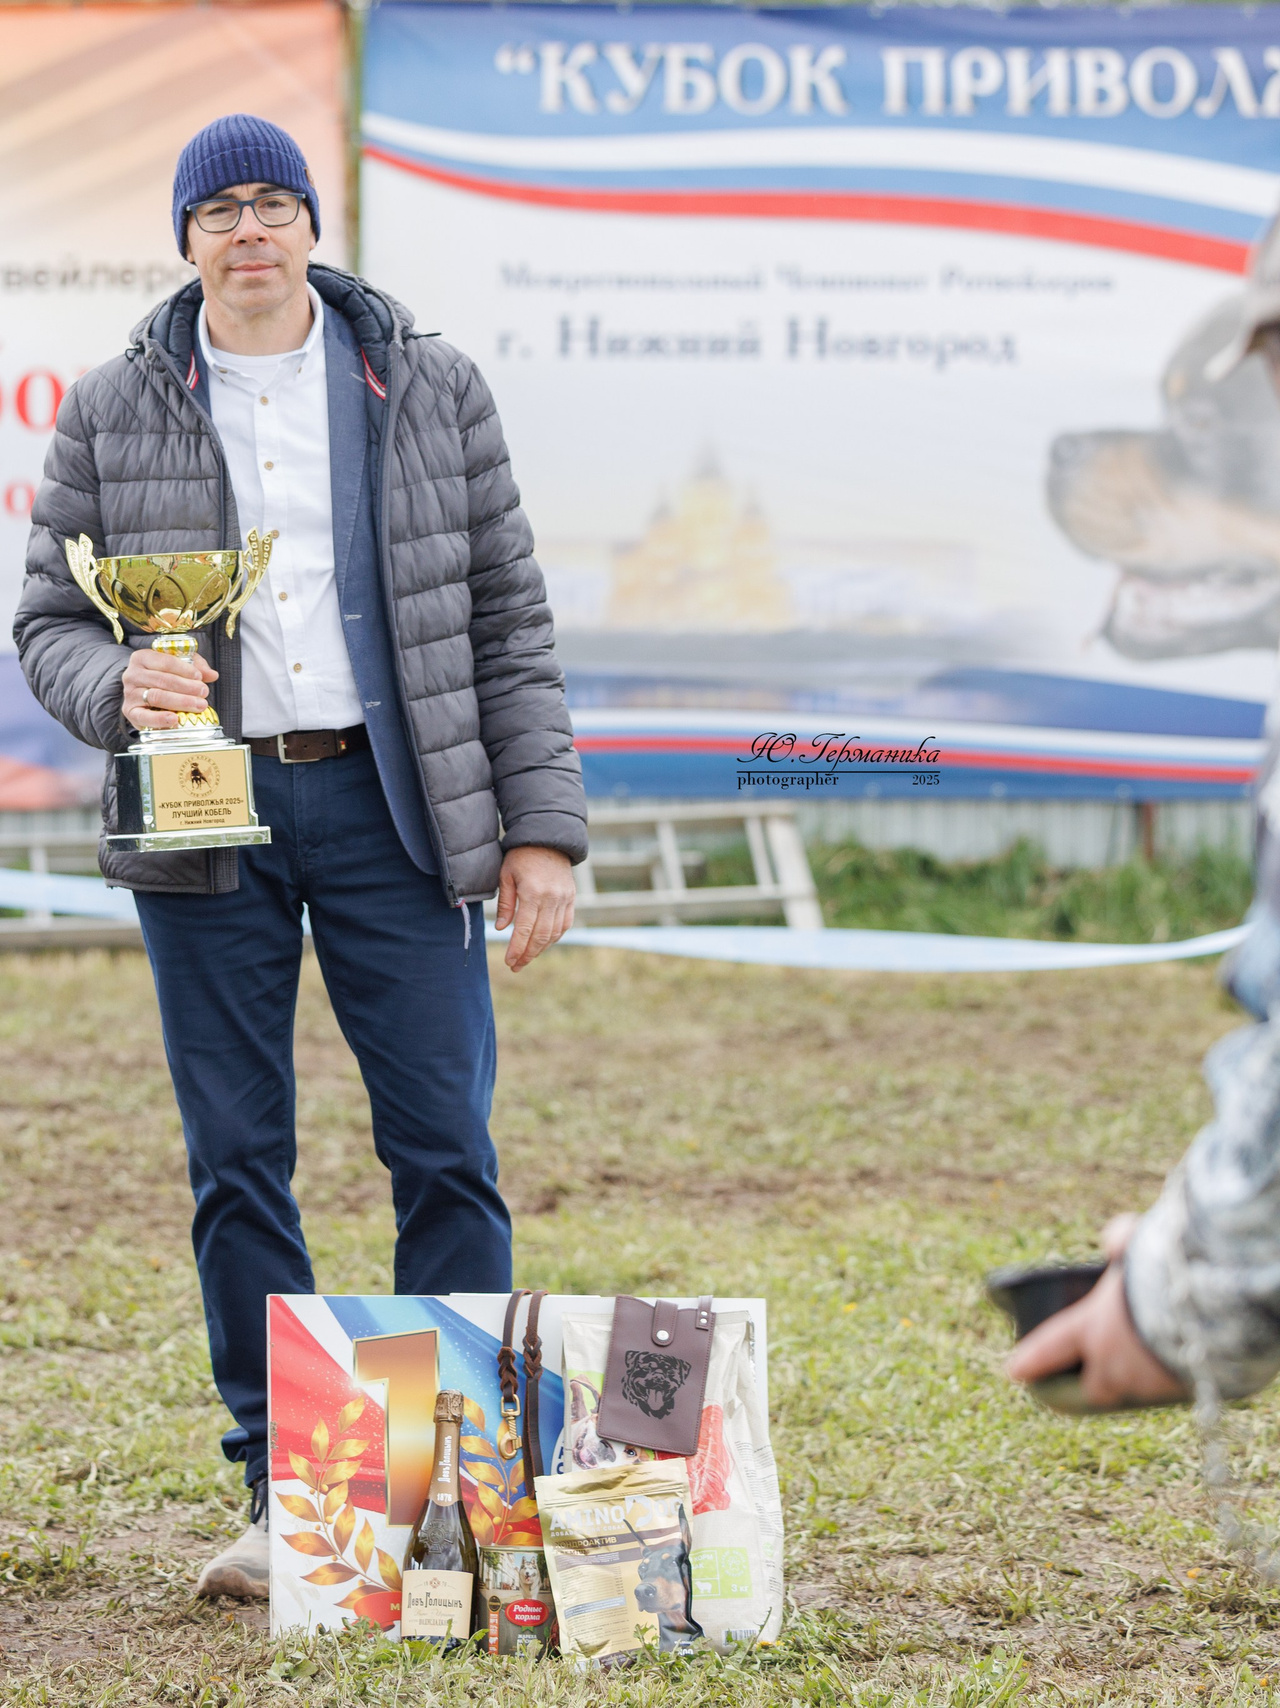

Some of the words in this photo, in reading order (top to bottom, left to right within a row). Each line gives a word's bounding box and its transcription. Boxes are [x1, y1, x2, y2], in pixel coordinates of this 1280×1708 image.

[559, 315, 761, 358] Нижний
[787, 315, 1017, 370] Новгород
[183, 799, 224, 808] ПРИВОЛЖЬЯ
[172, 807, 203, 819] ЛУЧШИЙ
[204, 808, 232, 817] КОБЕЛЬ
[731, 1584, 738, 1593] 3
[513, 1604, 543, 1613] Родные
[515, 1614, 540, 1622] корма
